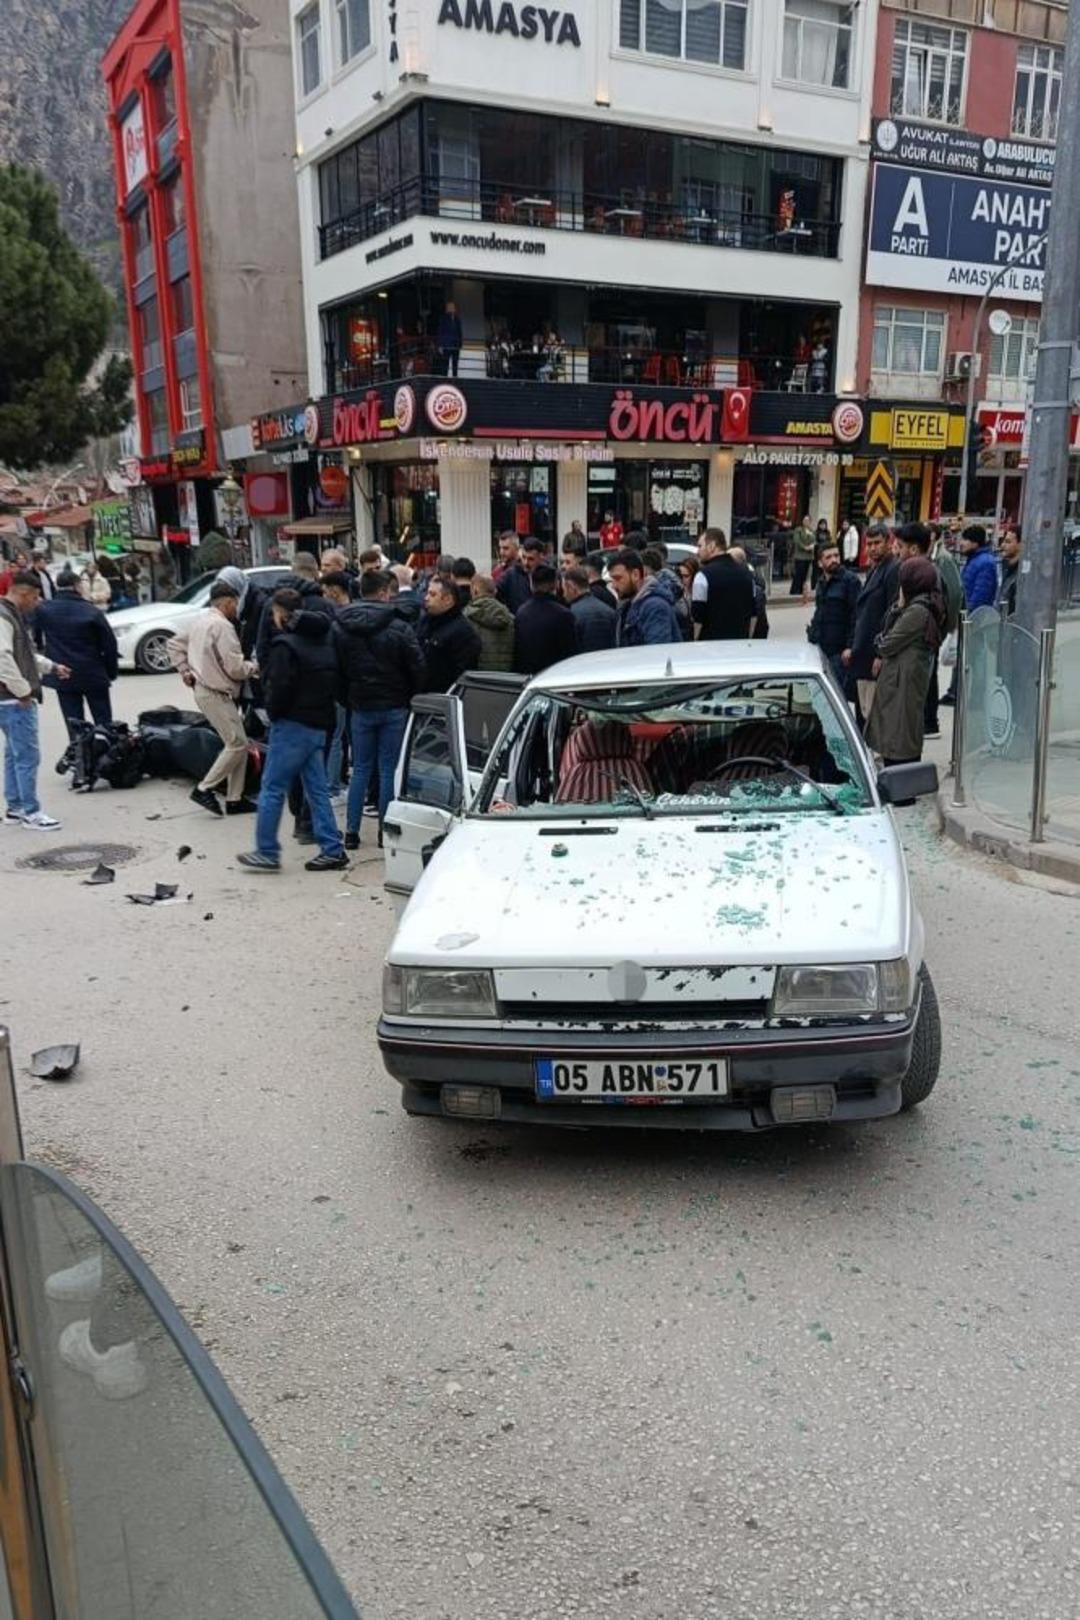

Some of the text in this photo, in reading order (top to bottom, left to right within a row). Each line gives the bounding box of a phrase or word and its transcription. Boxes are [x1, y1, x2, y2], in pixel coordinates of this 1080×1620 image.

[437, 0, 581, 48] AMASYA
[901, 126, 949, 144] AVUKAT
[900, 144, 928, 162] UĞUR
[929, 149, 946, 164] ALİ
[947, 153, 979, 172] AKTAŞ
[997, 142, 1056, 165] ARABULUCU
[892, 176, 929, 236] A
[430, 231, 546, 255] www.oncudoner.com
[891, 236, 929, 256] PARTİ
[947, 267, 1005, 289] AMASYA
[1008, 269, 1019, 290] İL
[896, 414, 944, 436] EYFEL
[743, 451, 767, 465] ALO
[769, 452, 802, 466] PAKET
[554, 1064, 719, 1092] 05 ABN 571
